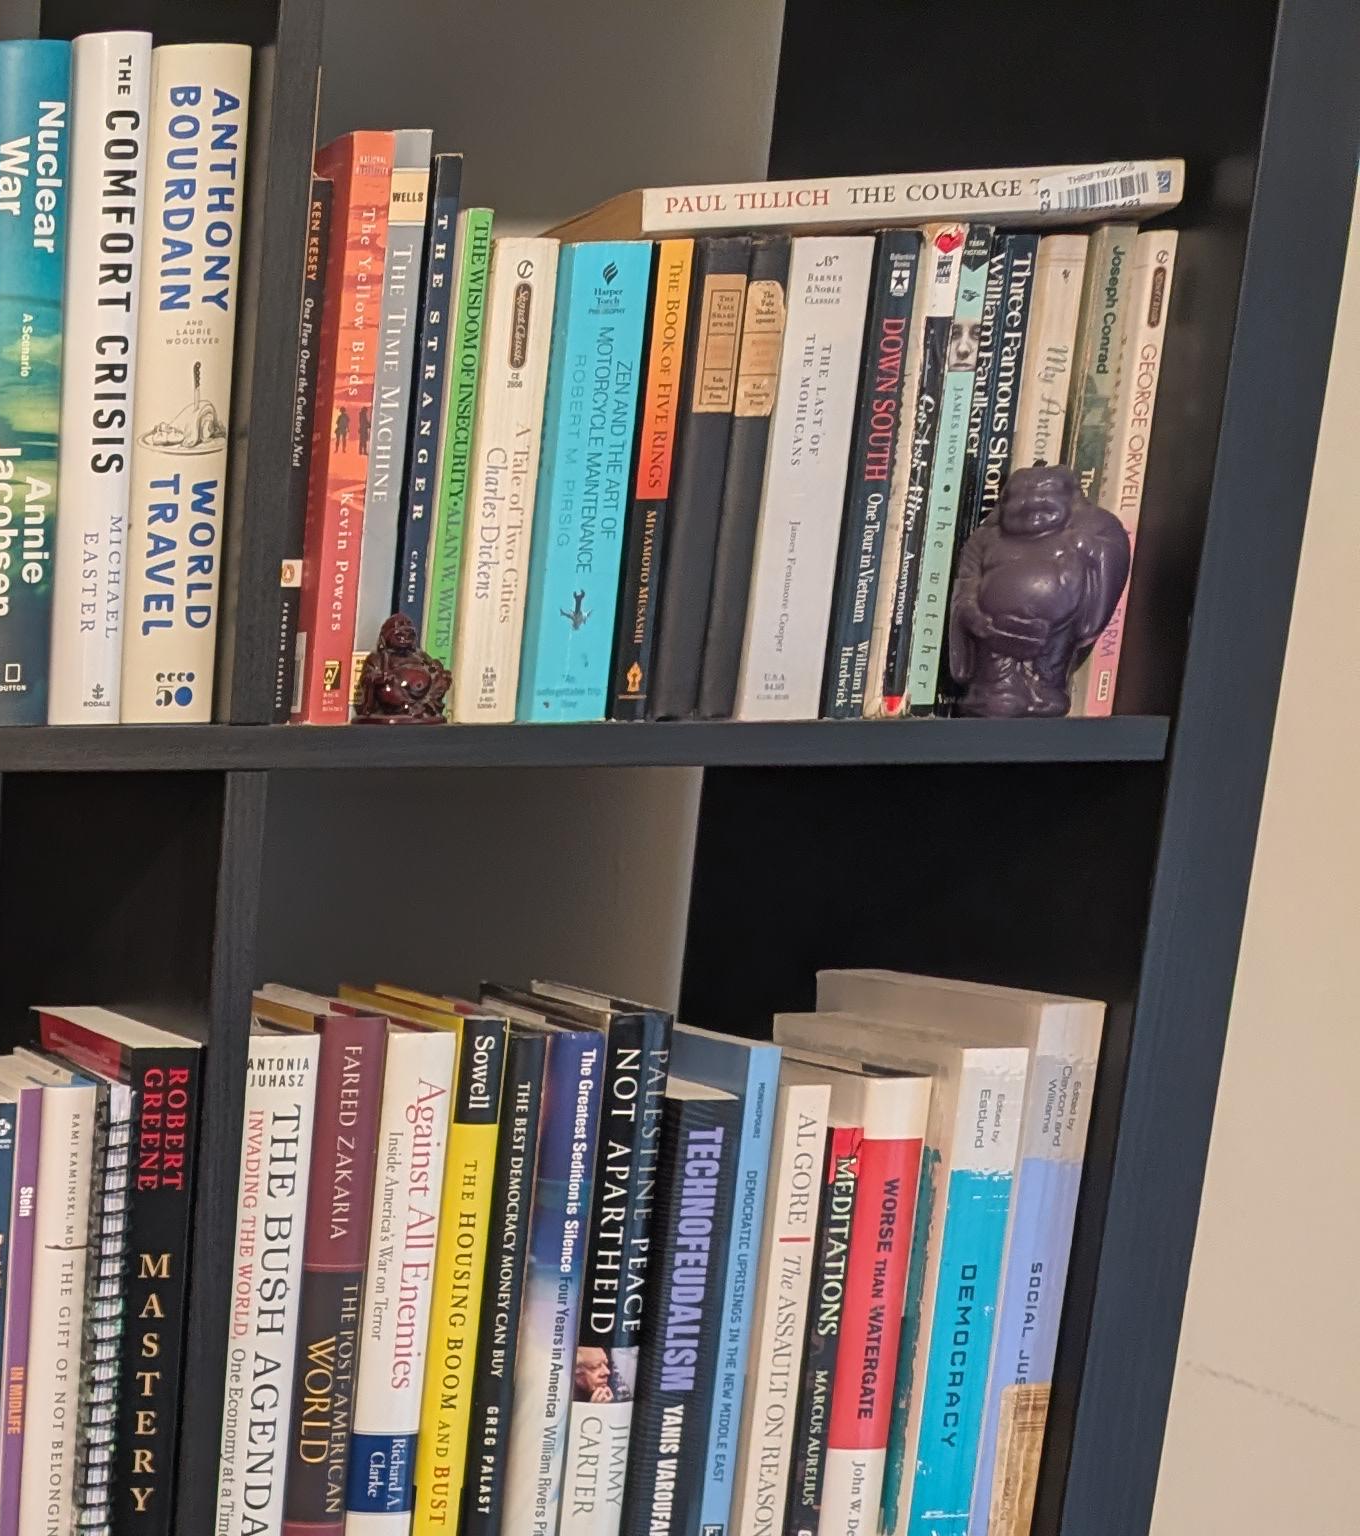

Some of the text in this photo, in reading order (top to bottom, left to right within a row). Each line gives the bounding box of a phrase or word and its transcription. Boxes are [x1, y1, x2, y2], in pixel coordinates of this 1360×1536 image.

[0, 135, 30, 215] War
[33, 100, 64, 254] Nuclear
[159, 85, 201, 312] BOURDAIN
[201, 88, 241, 312] ANTHONY
[393, 192, 424, 203] WELLS
[665, 179, 1022, 214] PAUL TILLICH THE COURAGE
[90, 55, 140, 474] THE COMFORT CRISIS
[864, 316, 906, 481] DOWN SOUTH
[19, 476, 49, 585] Annie
[141, 473, 181, 637] TRAVEL
[183, 480, 219, 631] WORLD
[137, 1068, 166, 1191] GREENE
[162, 1068, 188, 1191] ROBERT
[247, 1057, 310, 1071] ANTONIA
[250, 1074, 304, 1088] JUHASZ
[469, 1034, 496, 1111] Sowell
[266, 1105, 301, 1199] THE
[660, 1126, 724, 1392] TECHNOFEUDALISM
[133, 1252, 172, 1512] MASTERY
[940, 1264, 977, 1449] DEMOCRACY
